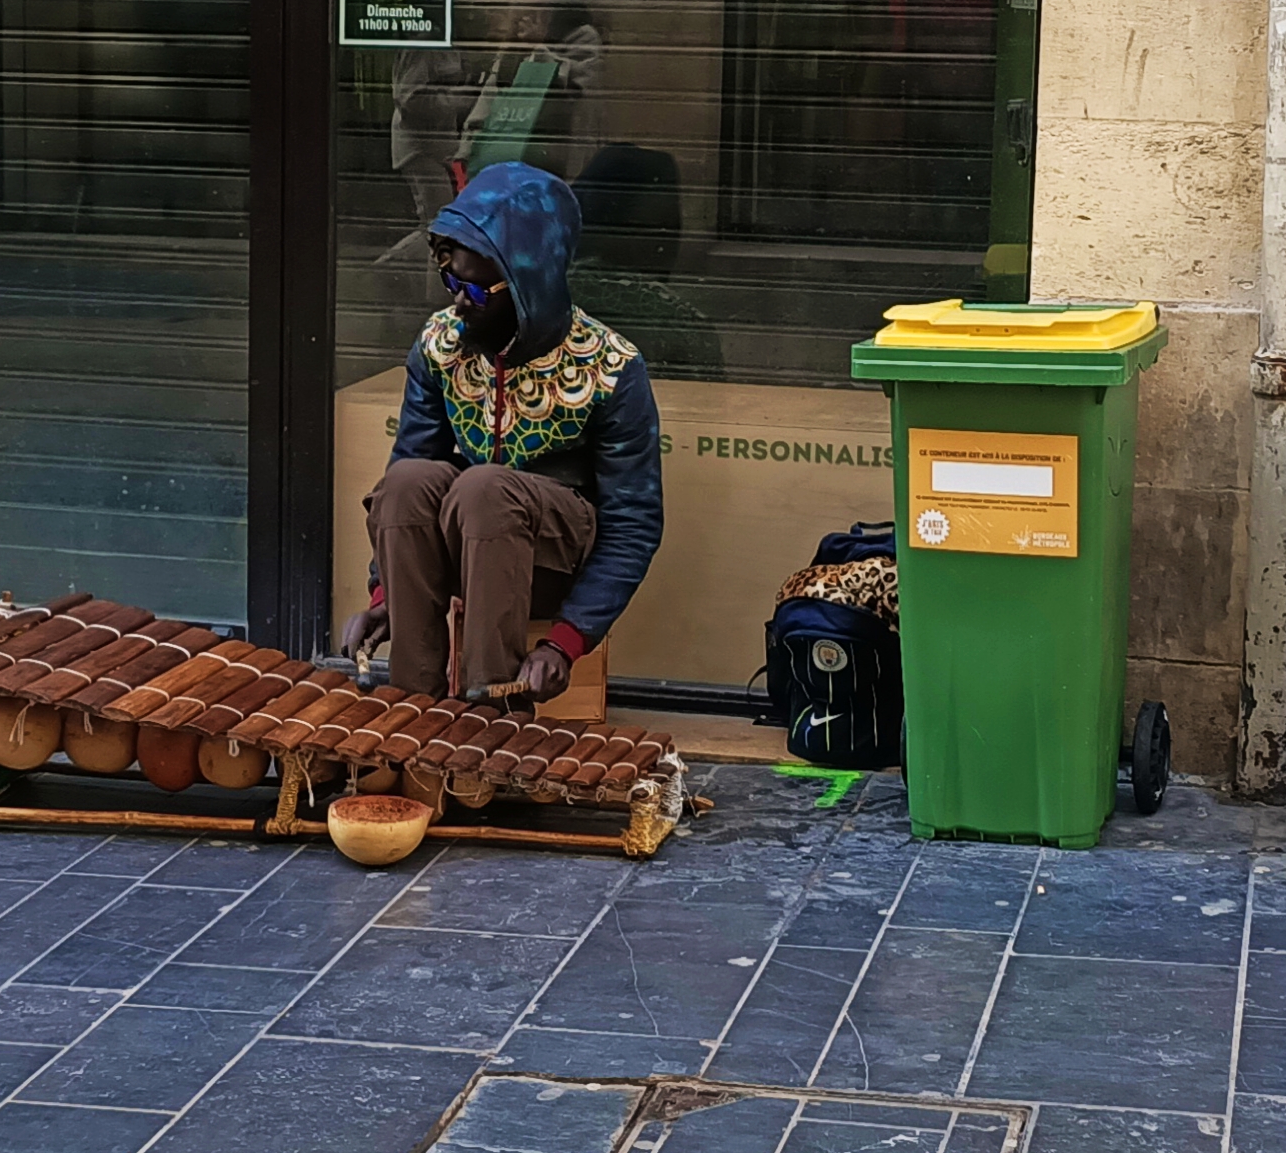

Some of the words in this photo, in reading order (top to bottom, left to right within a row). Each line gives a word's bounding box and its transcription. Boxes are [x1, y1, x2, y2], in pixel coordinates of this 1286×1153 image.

[367, 4, 423, 18] Dimanche
[359, 19, 389, 31] 11h00
[392, 20, 398, 31] à
[401, 20, 432, 31] 19h00
